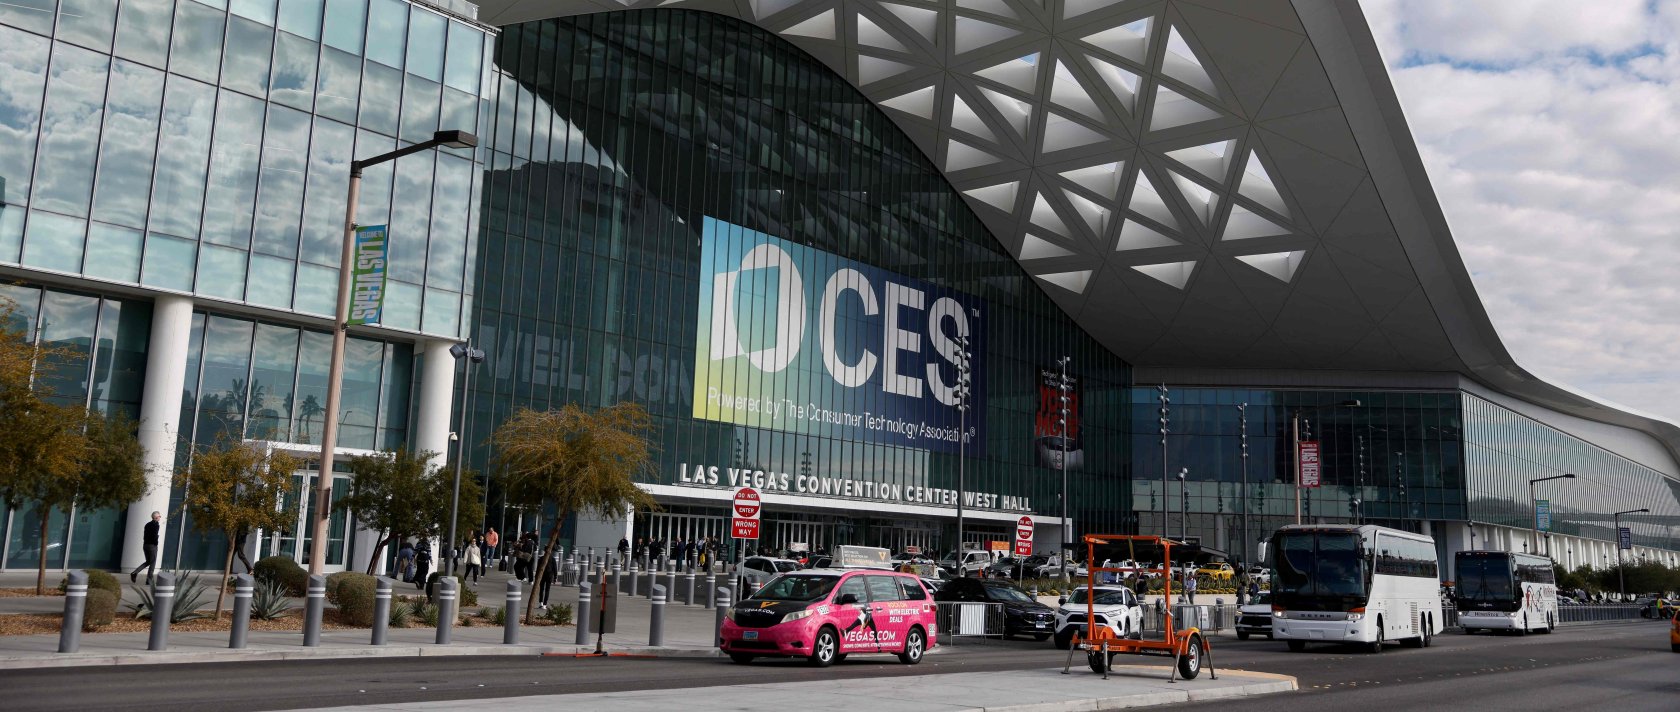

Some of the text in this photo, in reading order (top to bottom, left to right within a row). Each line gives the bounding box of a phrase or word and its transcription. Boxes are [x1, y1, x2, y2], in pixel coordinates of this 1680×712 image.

[352, 240, 384, 319] LAS VEGAS
[819, 268, 970, 406] CES
[766, 396, 781, 419] by
[782, 399, 803, 419] The
[807, 403, 862, 428] Consumer
[864, 411, 918, 439] Technology
[1302, 448, 1318, 462] LAS
[1302, 463, 1318, 485] VEGAS
[679, 463, 1031, 512] LAS VEGAS CONVENTION CENTER WEST HALL
[844, 630, 896, 642] VEGAS.COM
